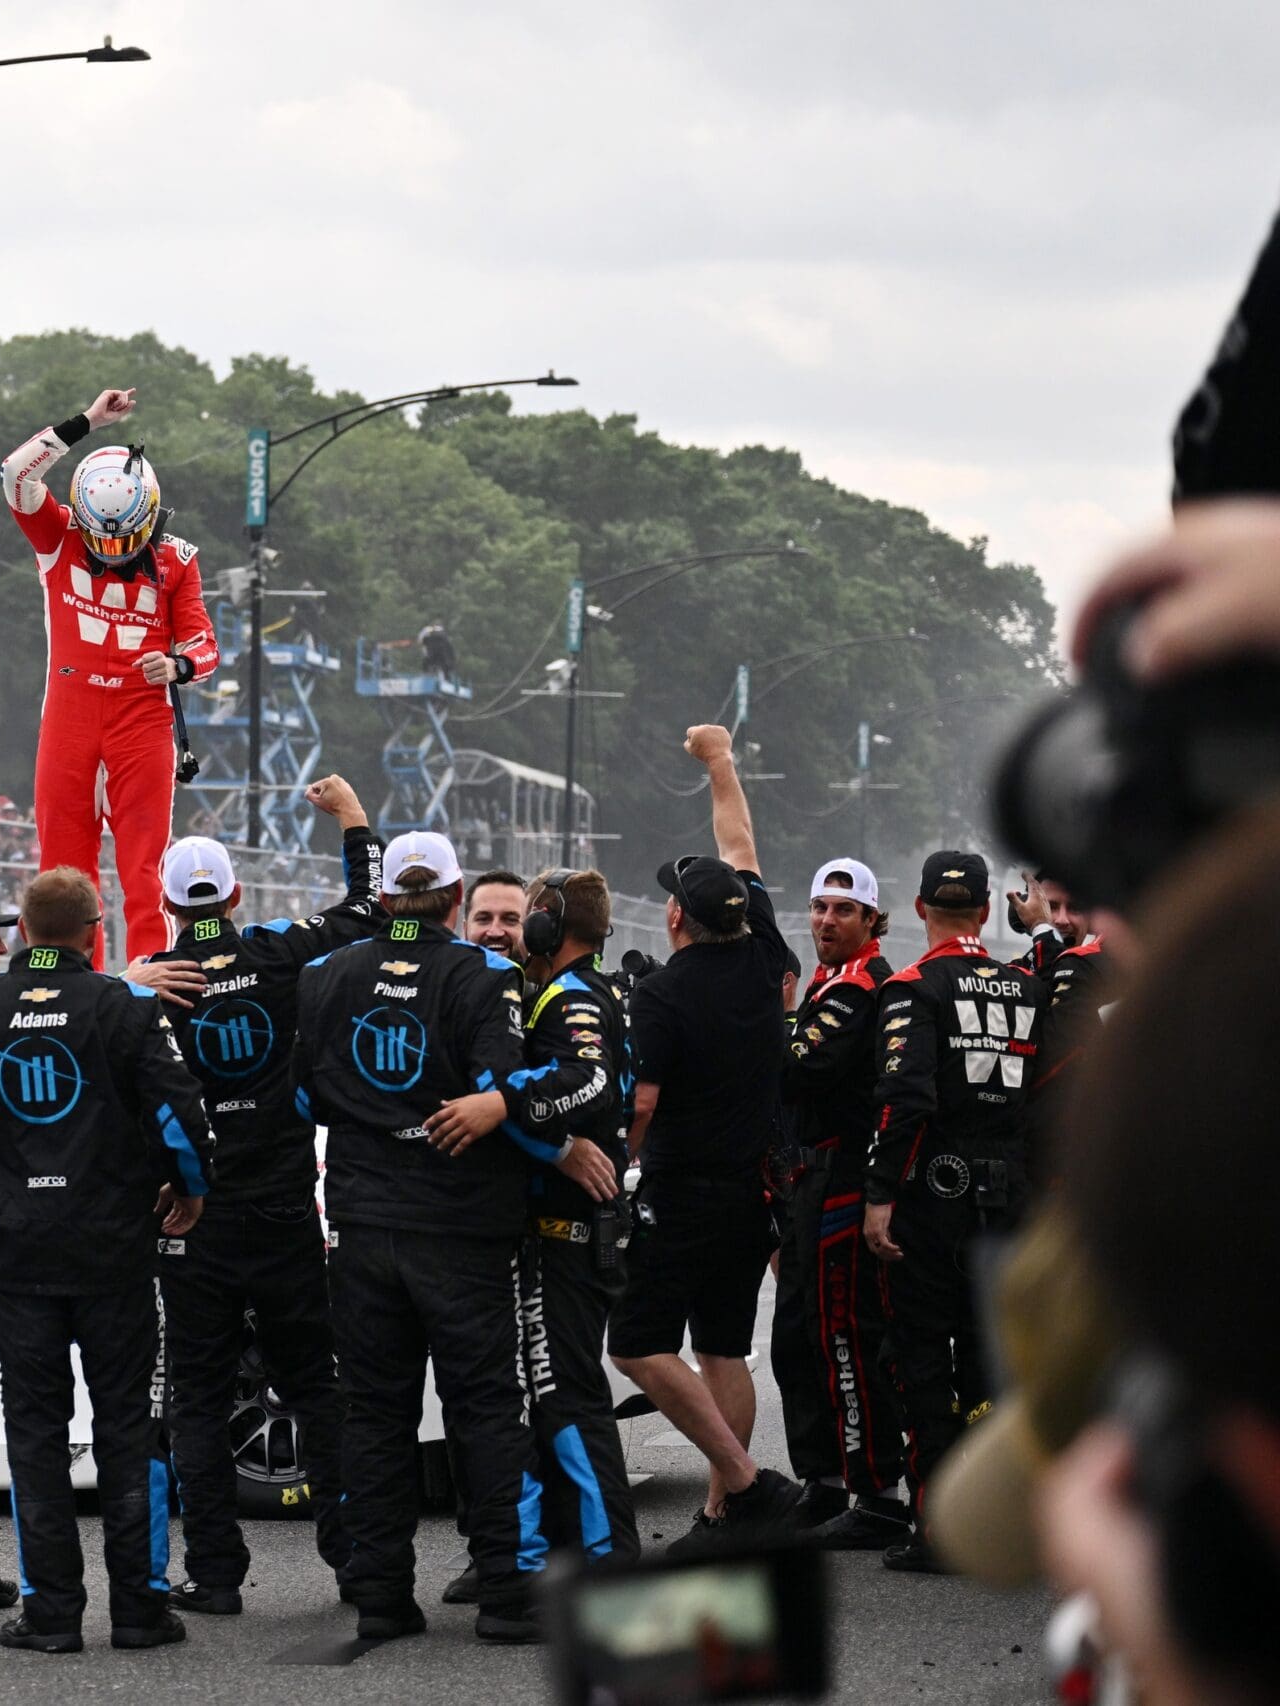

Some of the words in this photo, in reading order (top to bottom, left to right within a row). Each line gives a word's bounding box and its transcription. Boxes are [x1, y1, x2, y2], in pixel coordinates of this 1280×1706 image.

[30, 451, 50, 468] GIVES
[17, 468, 31, 481] YOU
[249, 439, 266, 516] C521
[62, 592, 164, 628] WeatherTech
[195, 919, 221, 941] 88
[391, 920, 419, 940] 88
[28, 948, 60, 969] 88
[374, 982, 418, 1001] Phillips
[958, 976, 1022, 997] MULDER
[9, 1012, 68, 1028] Adams
[949, 1036, 1037, 1056] WeatherTech
[28, 1176, 67, 1188] sparco
